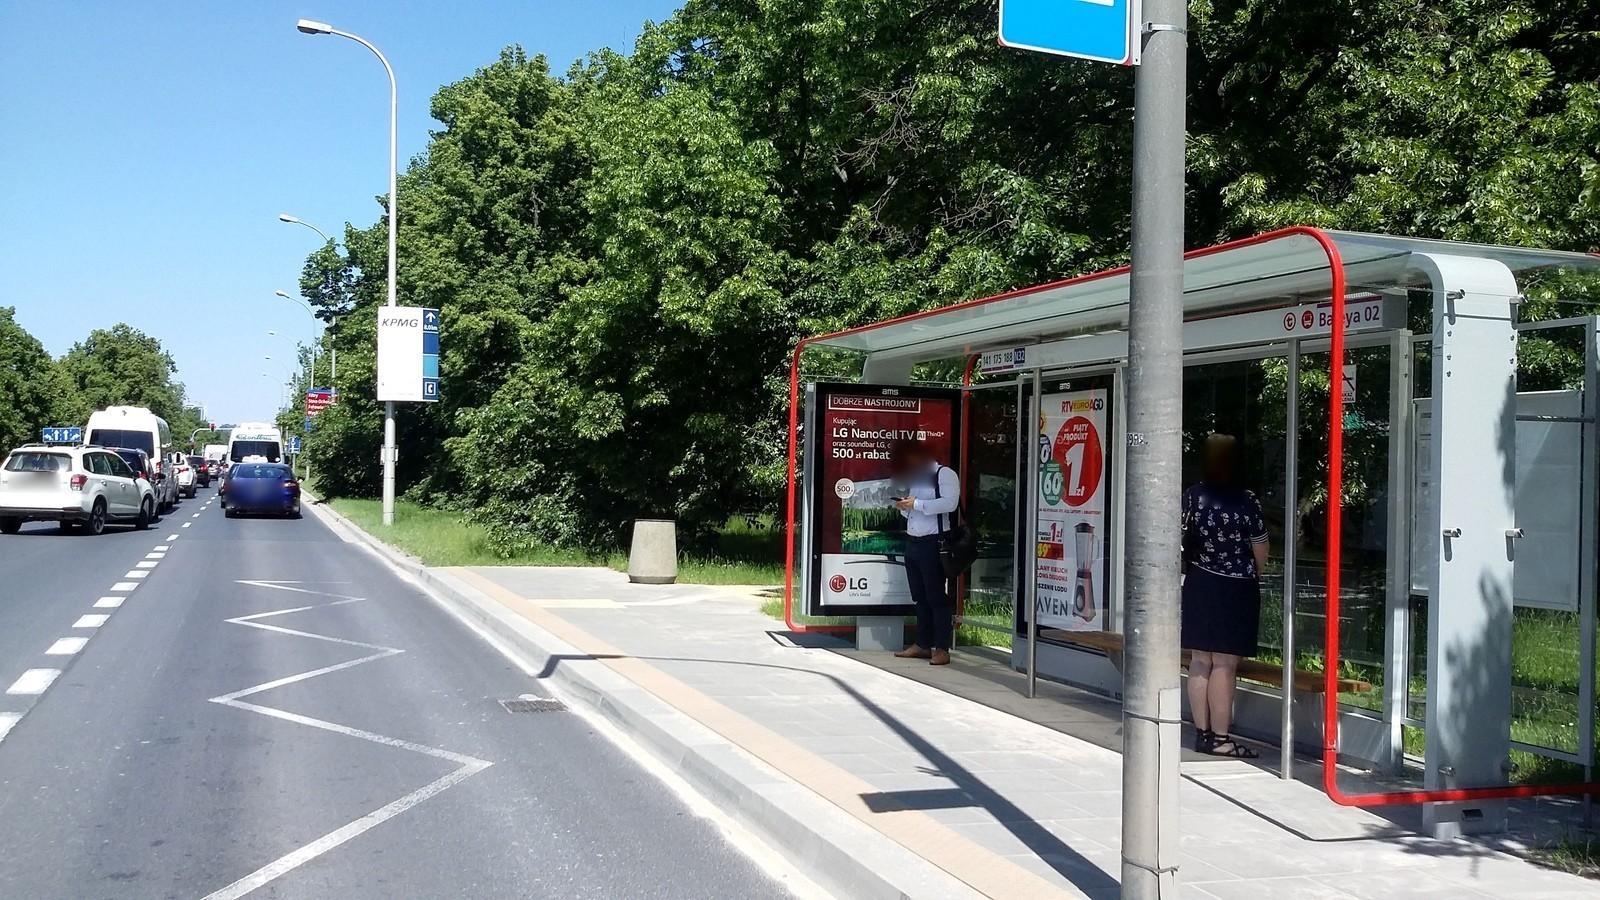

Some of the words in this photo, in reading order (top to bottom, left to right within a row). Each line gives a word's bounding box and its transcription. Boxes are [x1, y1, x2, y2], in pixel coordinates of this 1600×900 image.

[1319, 310, 1361, 328] Baya
[1364, 305, 1380, 321] 02
[382, 318, 418, 328] KPMG
[993, 353, 1002, 364] 175
[833, 396, 863, 406] DOBRZE
[864, 398, 917, 408] NASTROJONY
[833, 428, 848, 438] LG
[851, 428, 898, 440] NanoCell
[900, 430, 914, 440] TV
[847, 440, 875, 448] soundbar
[832, 448, 854, 459] 500
[1066, 442, 1085, 497] 1
[836, 485, 851, 493] 500
[1050, 522, 1056, 542] 1
[849, 577, 868, 590] LG
[1037, 596, 1068, 617] AVEN
